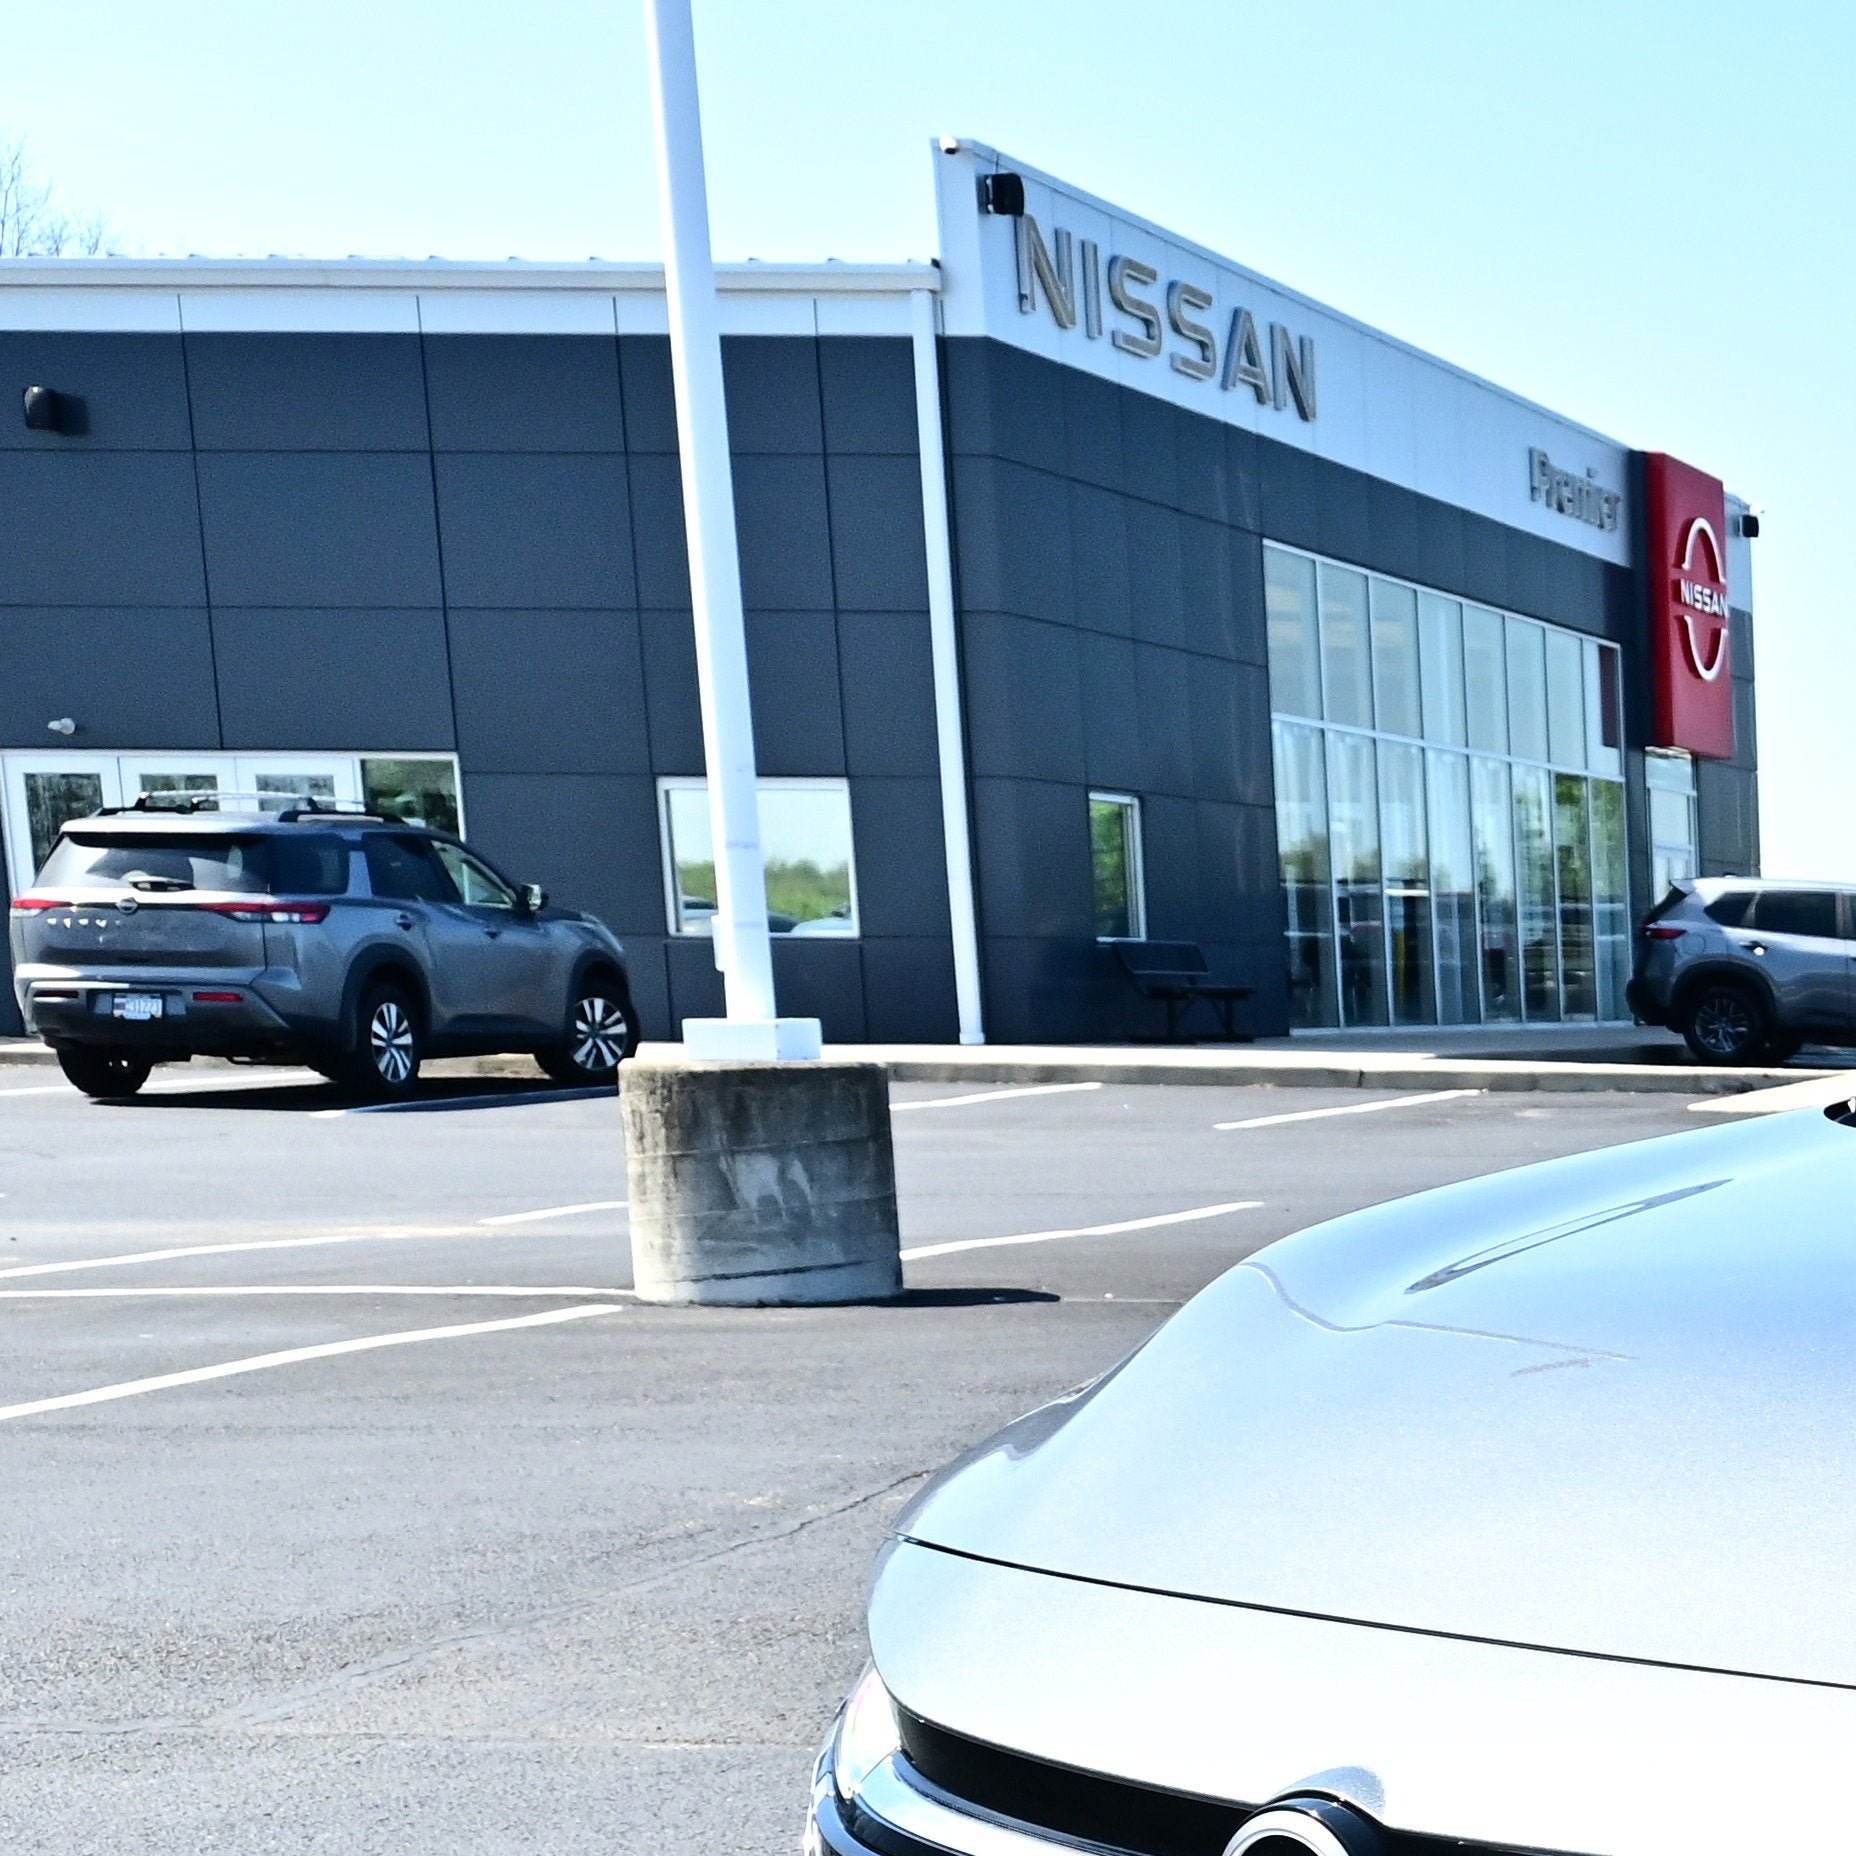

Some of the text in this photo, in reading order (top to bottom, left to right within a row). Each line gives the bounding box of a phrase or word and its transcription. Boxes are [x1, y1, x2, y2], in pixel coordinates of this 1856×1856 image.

[1015, 213, 1317, 422] NISSAN
[1529, 447, 1622, 532] Premier
[1681, 579, 1727, 619] NISSAN
